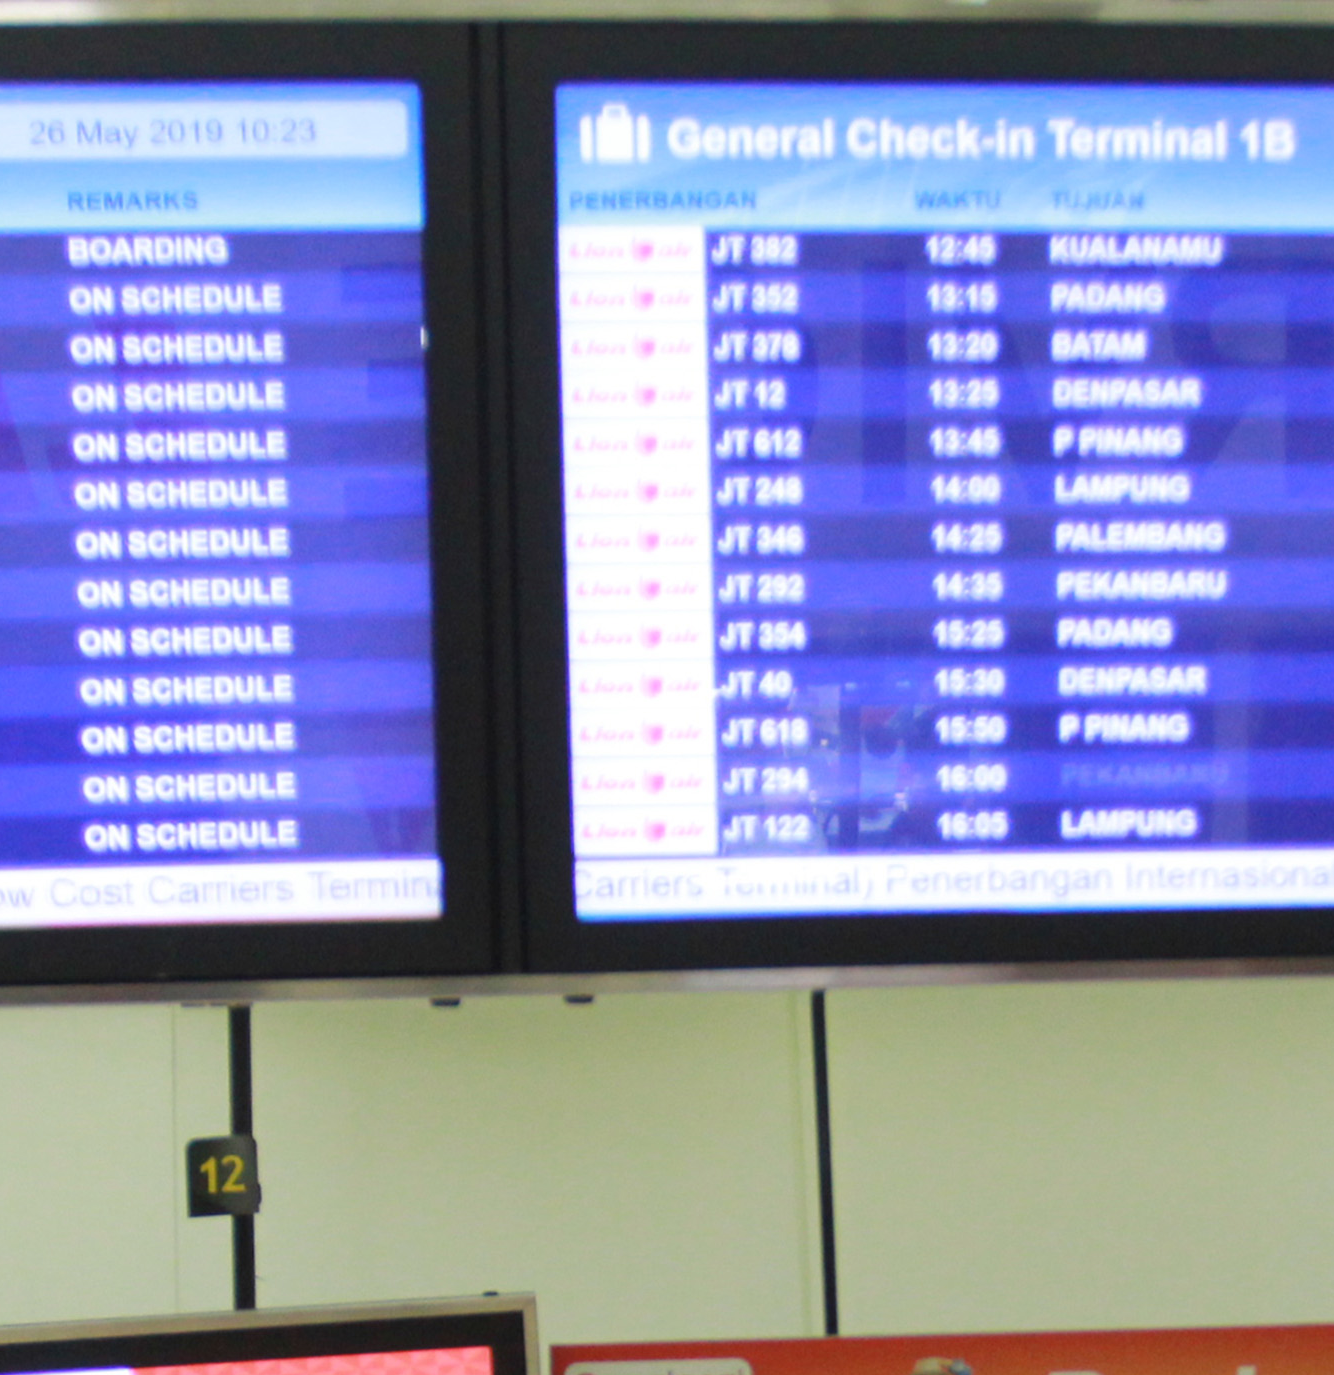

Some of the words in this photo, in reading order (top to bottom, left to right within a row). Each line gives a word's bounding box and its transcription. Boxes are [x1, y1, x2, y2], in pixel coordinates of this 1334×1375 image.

[30, 120, 65, 146] 26
[77, 118, 137, 149] May
[150, 117, 223, 145] 2019
[236, 117, 317, 145] 10:23
[668, 118, 835, 161] General
[847, 117, 1035, 160] Check-in
[1048, 117, 1227, 160] Terminal
[1239, 118, 1296, 160] 1B
[67, 190, 199, 212] REMARKS
[569, 188, 758, 211] PENERBANGAN
[69, 237, 228, 265] BOARDING
[70, 335, 114, 364] ON
[122, 332, 284, 362] SCHEDULE
[1052, 376, 1204, 407] DENPASAR
[74, 481, 119, 510] ON
[126, 477, 289, 509] SCHEDULE
[77, 580, 121, 609] ON
[129, 576, 291, 607] SCHEDULE
[1056, 569, 1229, 600] PEKANBARU
[84, 822, 128, 852] ON
[136, 818, 298, 849] SCHEDULE
[49, 877, 135, 908] Cost
[148, 874, 295, 906] Carriers
[885, 863, 1113, 899] Penerbangan
[200, 1154, 247, 1194] 12
